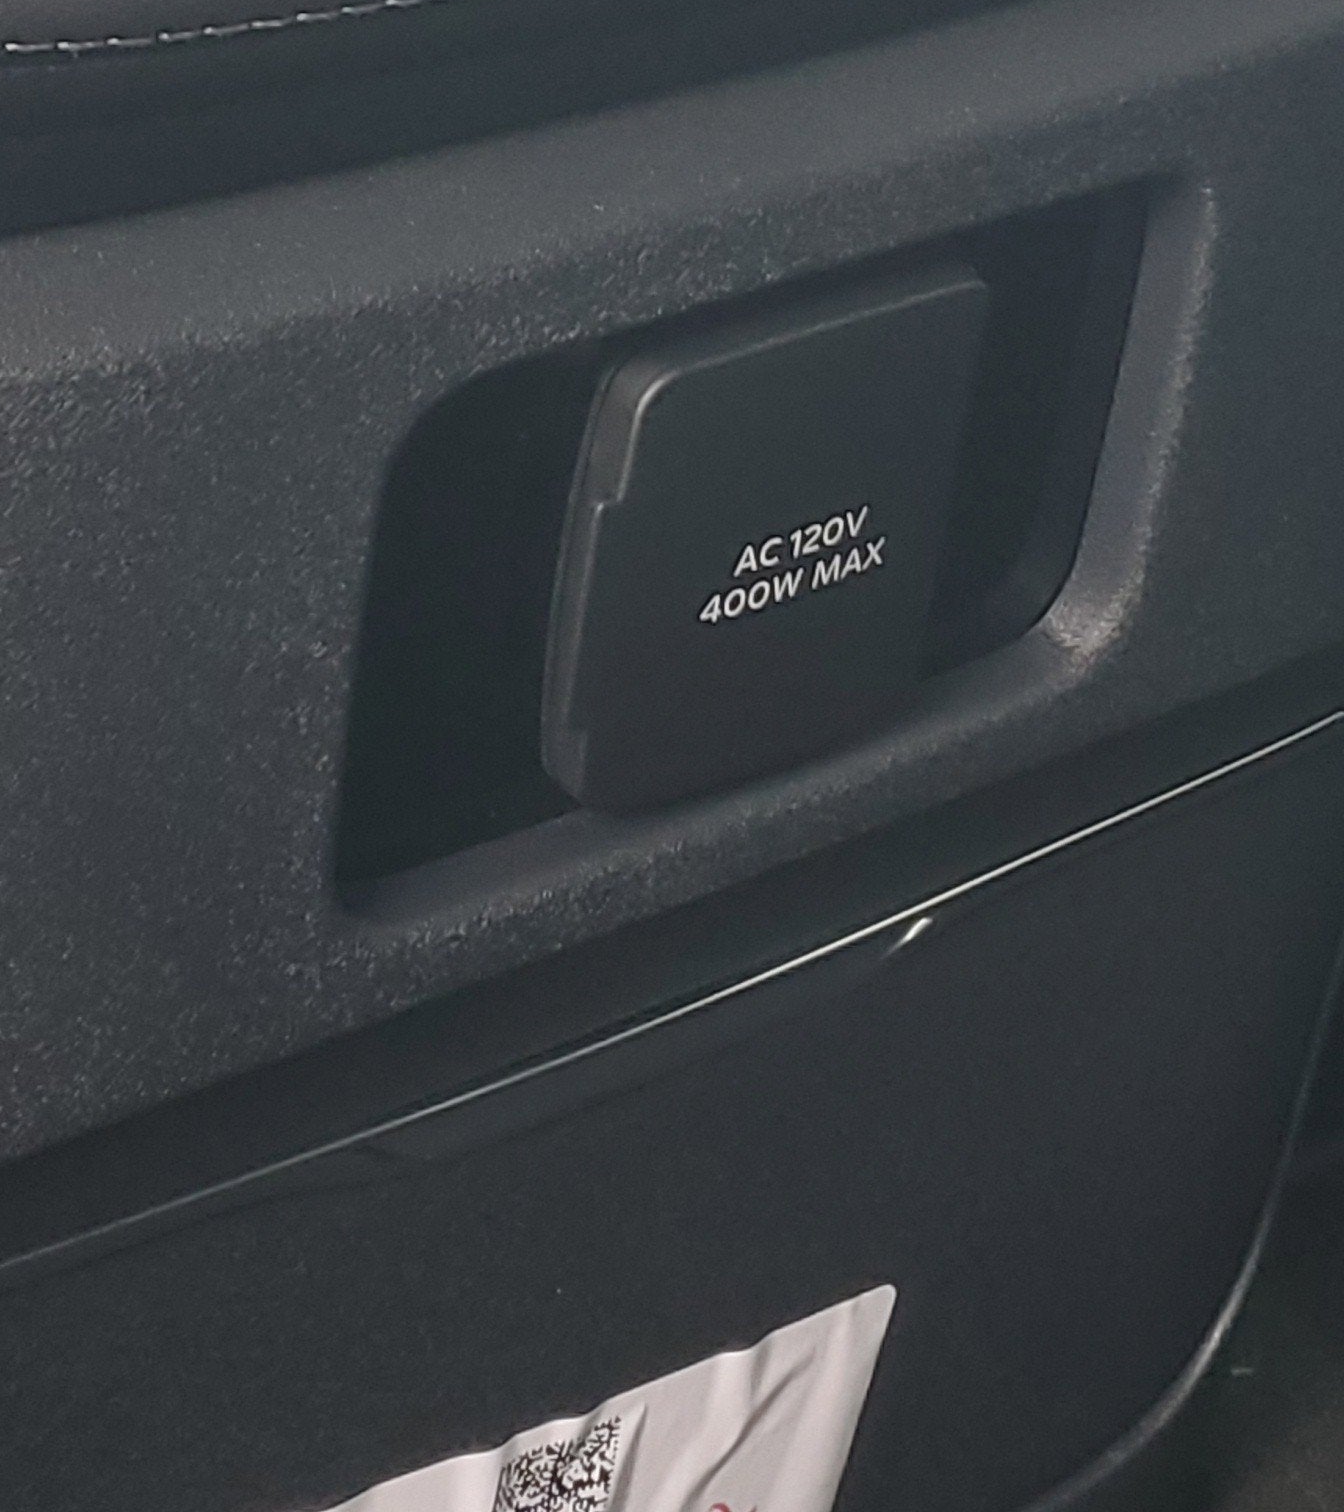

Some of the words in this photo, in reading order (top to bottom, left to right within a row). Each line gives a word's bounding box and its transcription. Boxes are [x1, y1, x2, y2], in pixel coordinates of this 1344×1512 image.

[699, 567, 805, 624] 400W
[811, 536, 886, 589] MAX
[733, 536, 784, 577] AC
[789, 505, 869, 558] 120V
